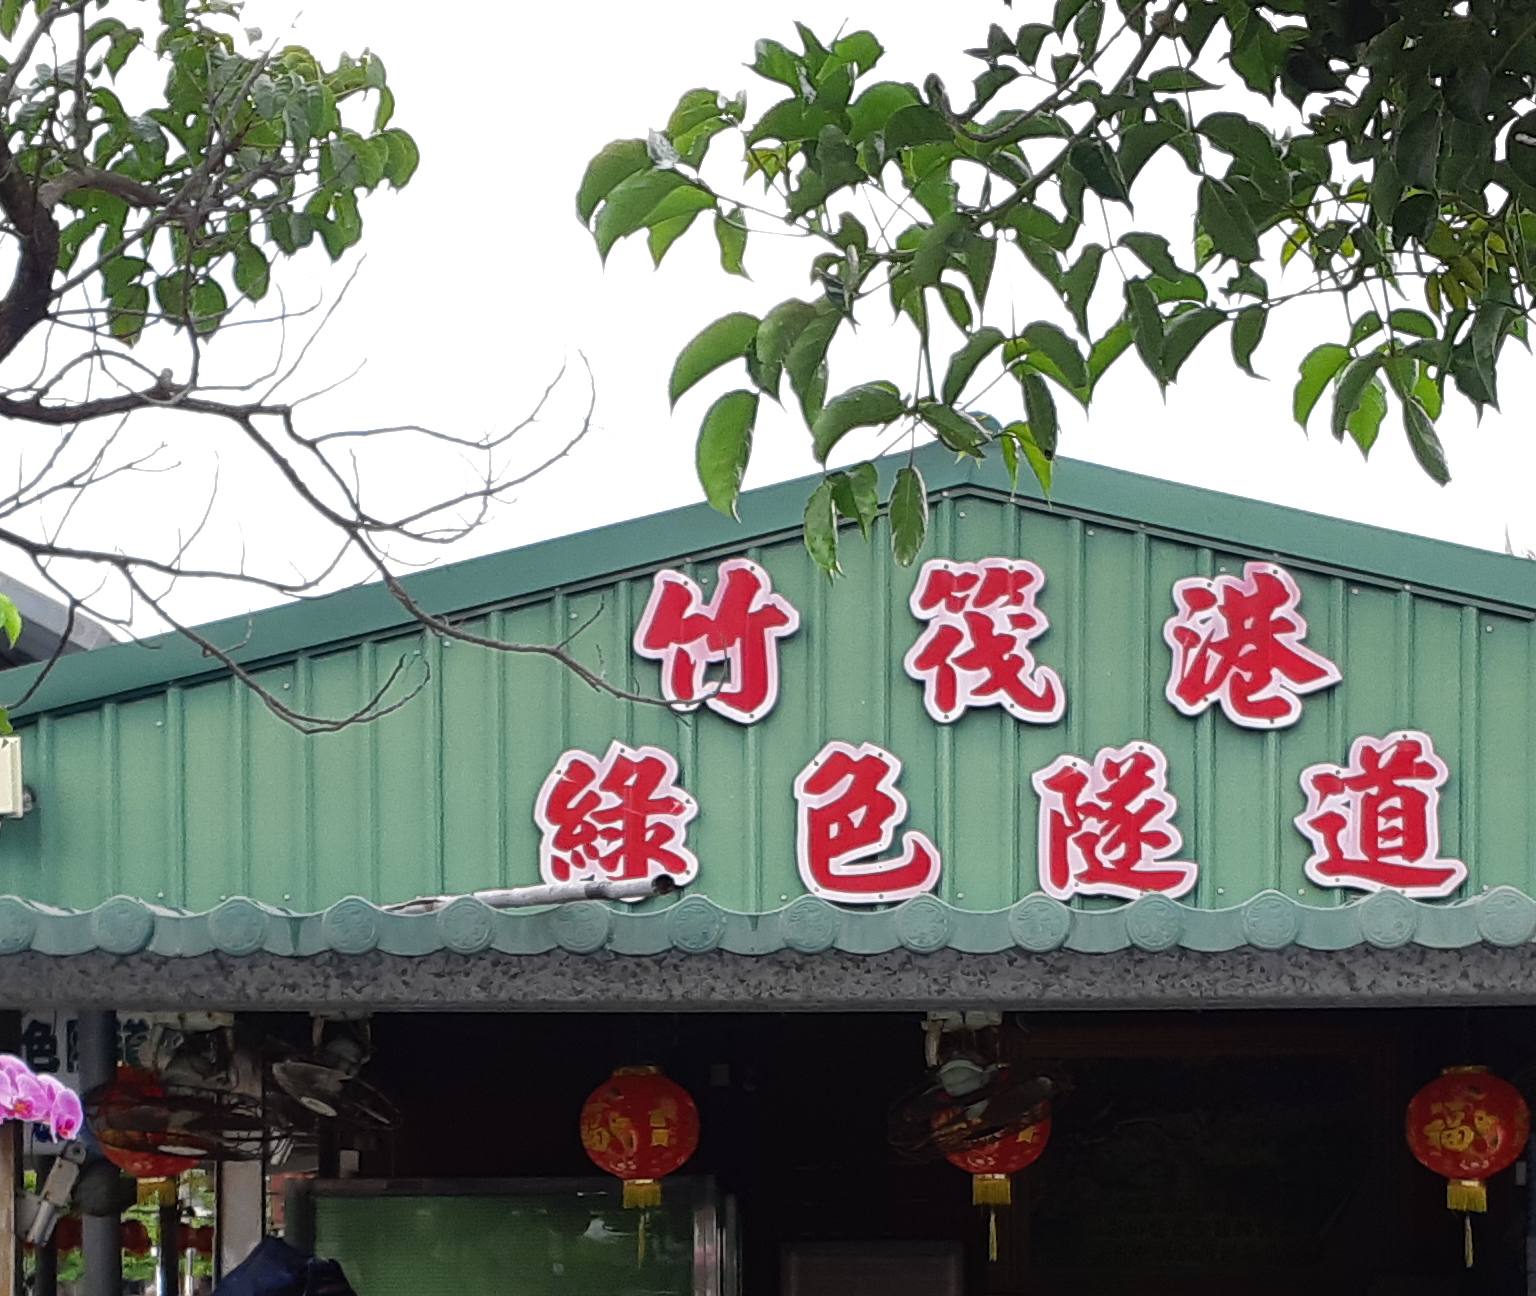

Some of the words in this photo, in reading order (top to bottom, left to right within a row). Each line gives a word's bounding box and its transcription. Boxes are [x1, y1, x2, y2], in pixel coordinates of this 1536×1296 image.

[634, 560, 1340, 728] 竹筏港
[537, 731, 1467, 901] 綠色隧道
